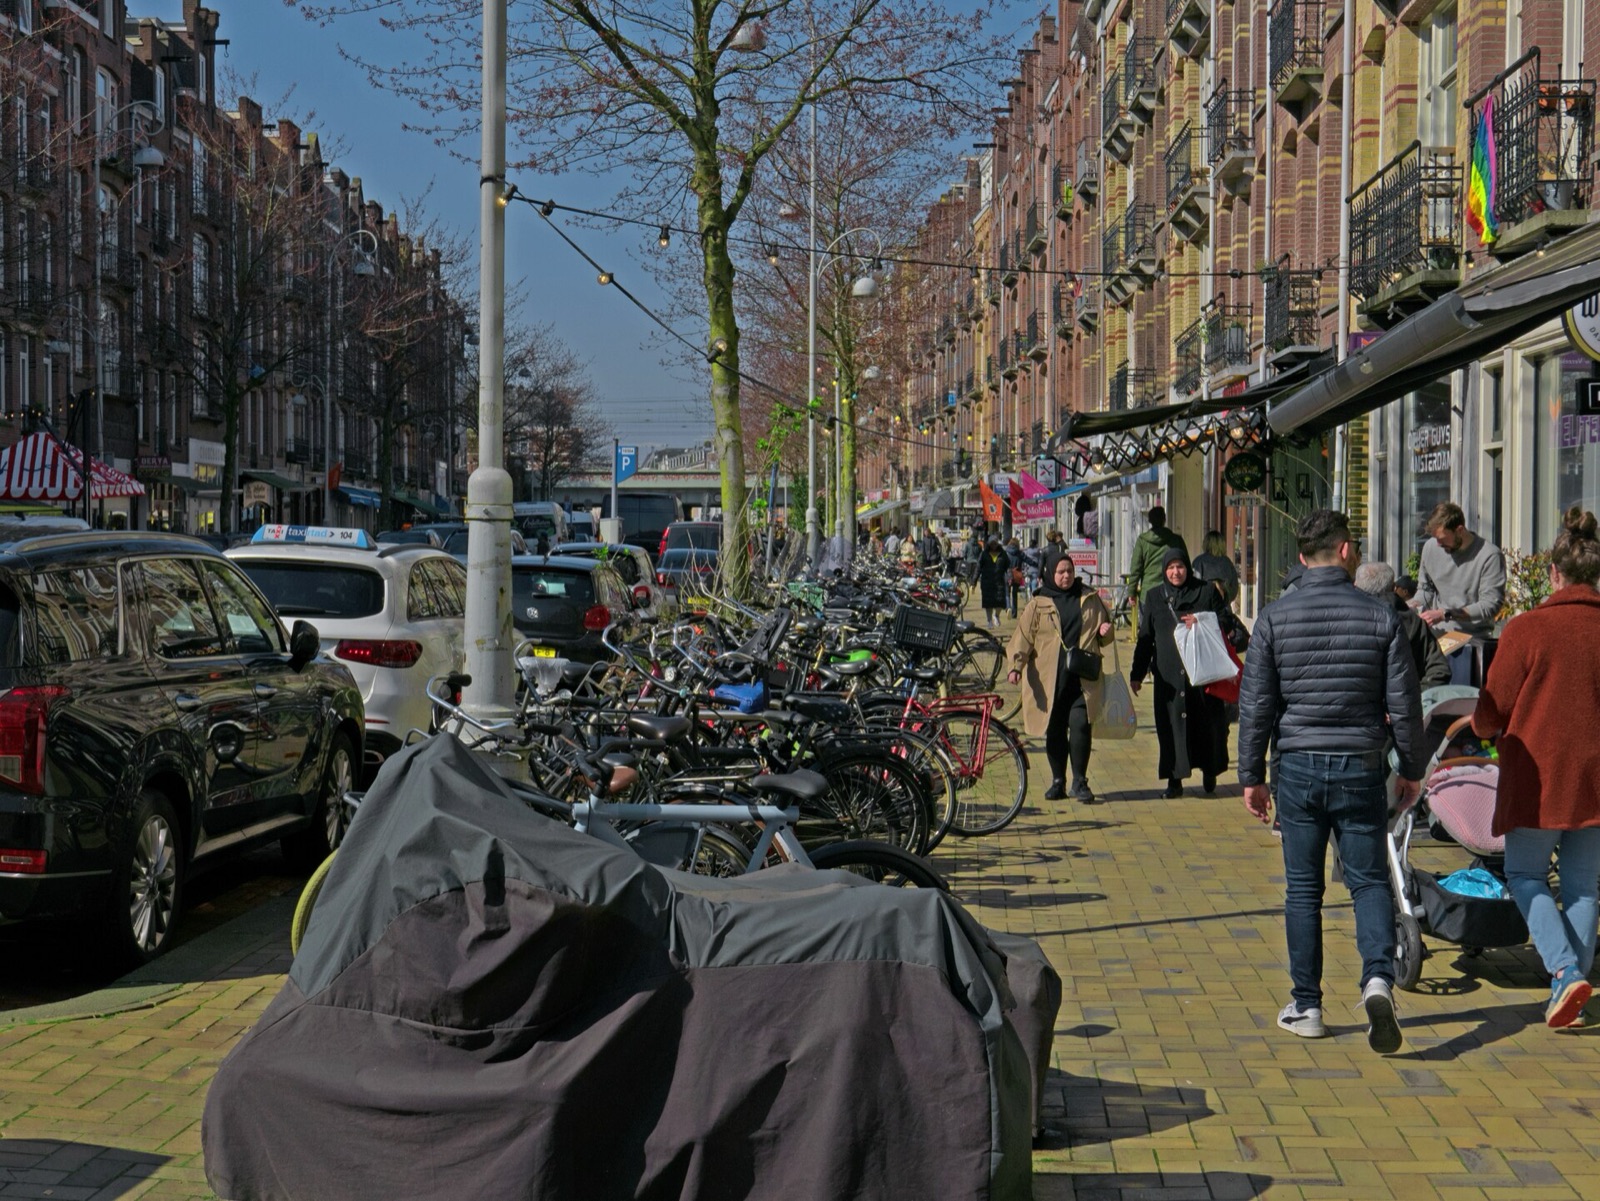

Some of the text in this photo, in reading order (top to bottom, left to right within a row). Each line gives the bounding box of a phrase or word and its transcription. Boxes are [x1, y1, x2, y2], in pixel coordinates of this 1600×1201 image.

[1431, 424, 1451, 446] GUYS
[622, 456, 632, 471] P
[1027, 504, 1053, 515] Mobile
[340, 531, 353, 540] 104
